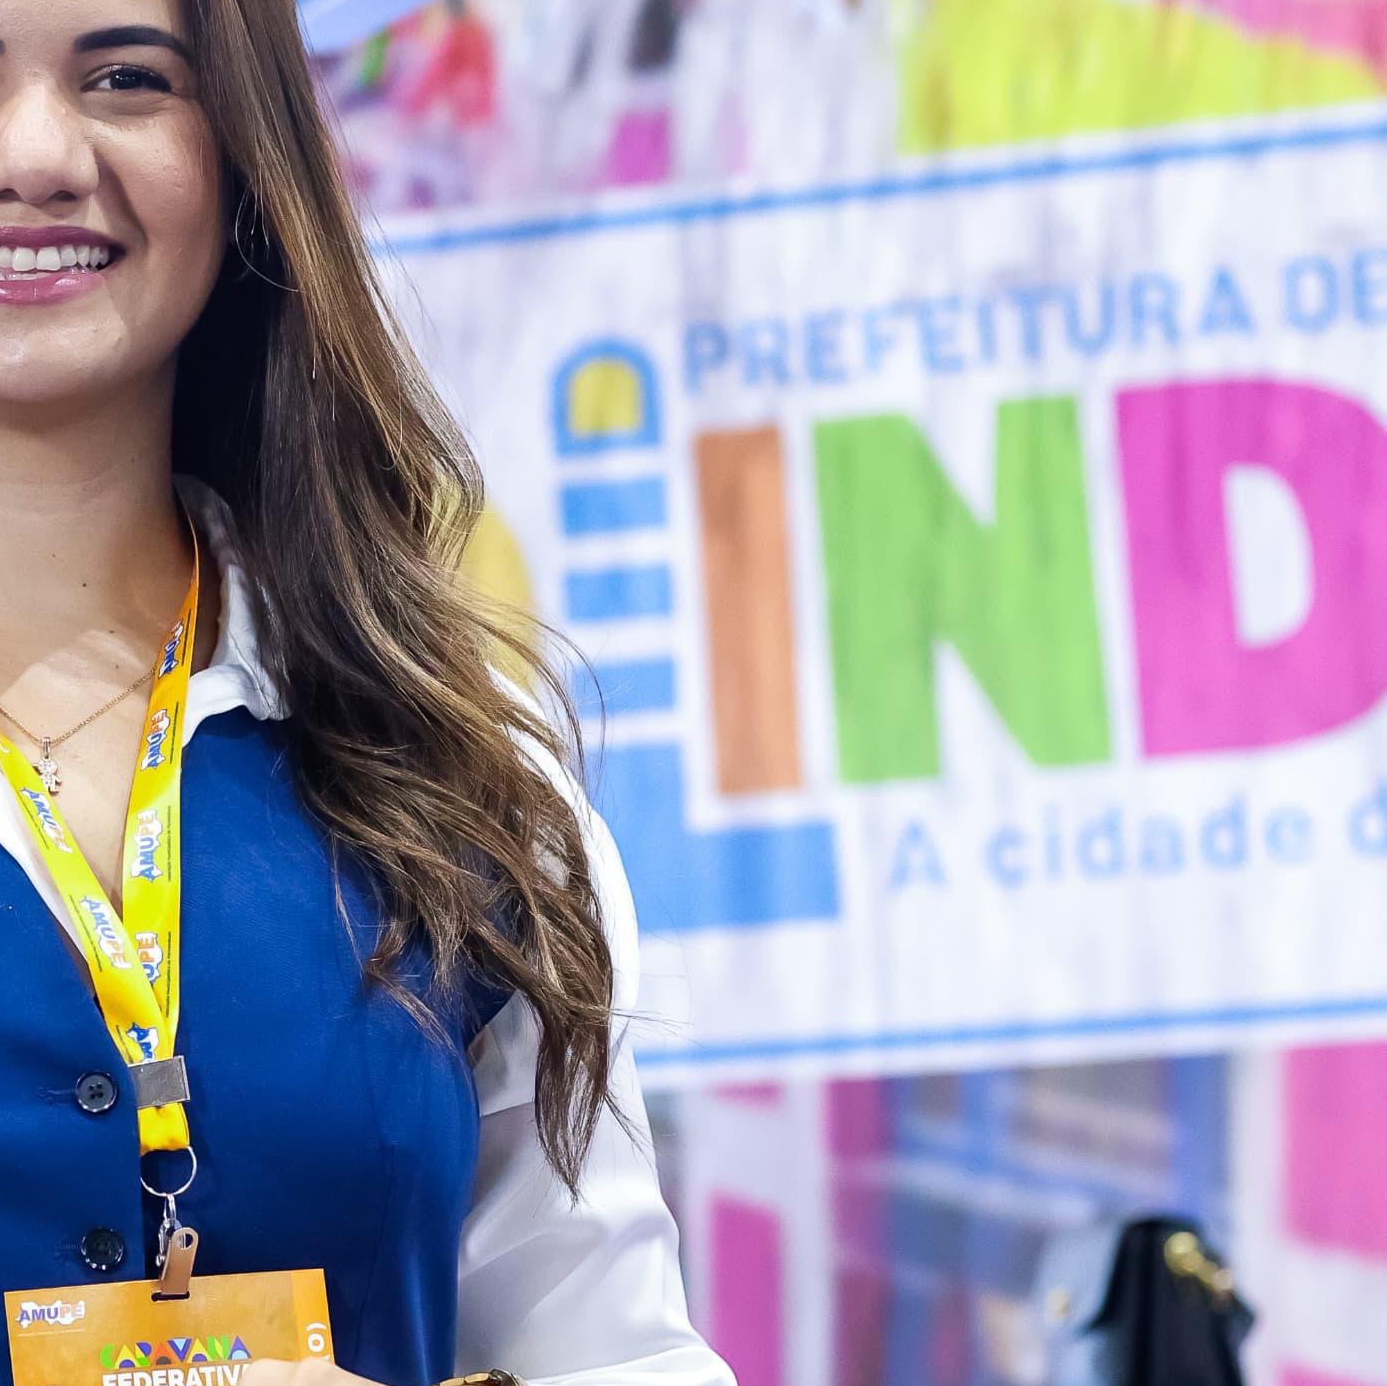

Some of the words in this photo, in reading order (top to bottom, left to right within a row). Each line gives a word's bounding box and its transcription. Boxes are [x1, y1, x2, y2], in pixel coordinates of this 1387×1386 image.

[682, 265, 1257, 397] PREFEITURA
[138, 811, 156, 881] AMUPE
[889, 816, 949, 891] A
[983, 791, 1315, 889] cidade
[84, 897, 127, 968] AMUPE
[19, 1302, 84, 1323] AMUPE
[100, 1334, 253, 1370] CARAVANA
